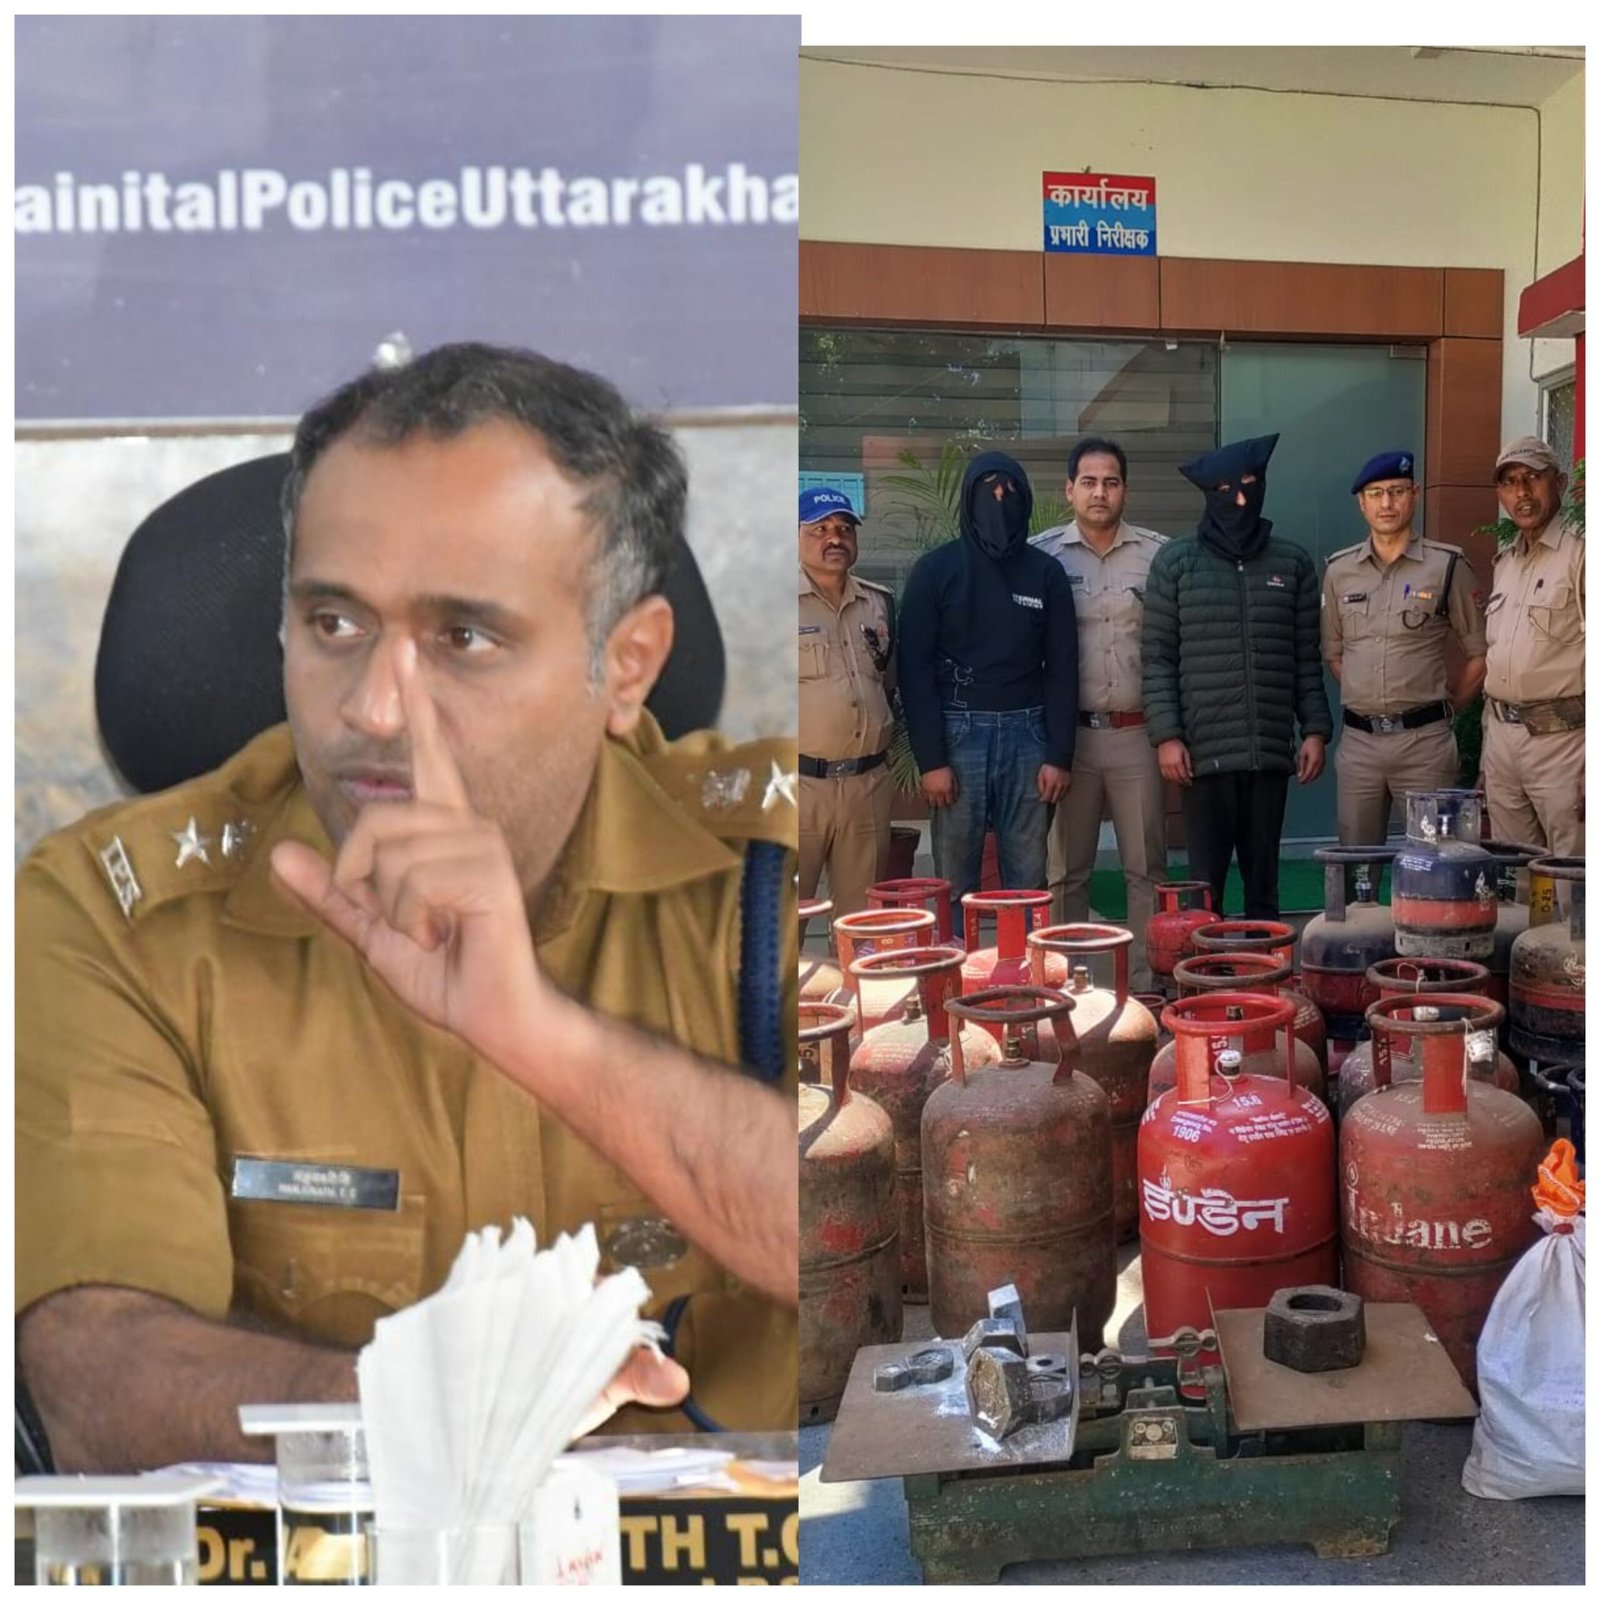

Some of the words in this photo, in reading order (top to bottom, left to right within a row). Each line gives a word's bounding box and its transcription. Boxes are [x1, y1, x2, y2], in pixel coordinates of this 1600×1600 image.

[1047, 178, 1149, 211] कार्यालय
[1049, 219, 1089, 247] प्रभारी
[1096, 220, 1149, 250] निरीक्षक
[813, 494, 847, 505] POLICE
[1172, 1124, 1201, 1143] 1906
[196, 1525, 267, 1581] Dr.
